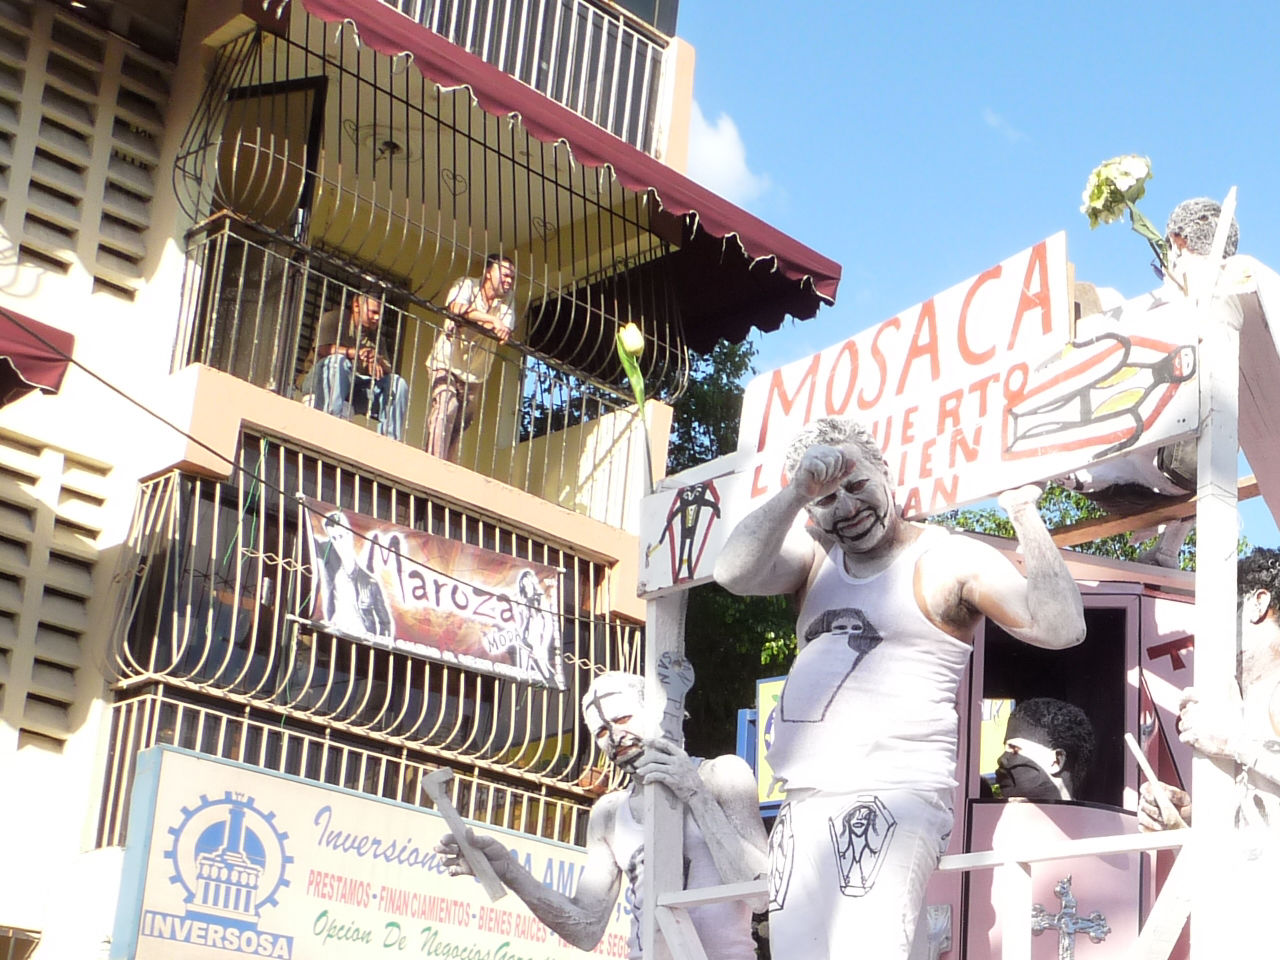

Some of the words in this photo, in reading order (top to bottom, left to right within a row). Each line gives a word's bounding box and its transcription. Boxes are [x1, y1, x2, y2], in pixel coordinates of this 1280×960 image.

[756, 240, 1054, 452] MOSACA
[871, 362, 1029, 455] UERTO
[313, 804, 450, 875] Inversione
[143, 911, 291, 960] INVERSOSA
[306, 869, 372, 909] PRESTAMOS
[478, 905, 513, 937] BIENES
[515, 911, 547, 943] RAICES
[607, 933, 631, 960] SEGU
[313, 909, 373, 946] Opcion
[382, 920, 407, 951] De
